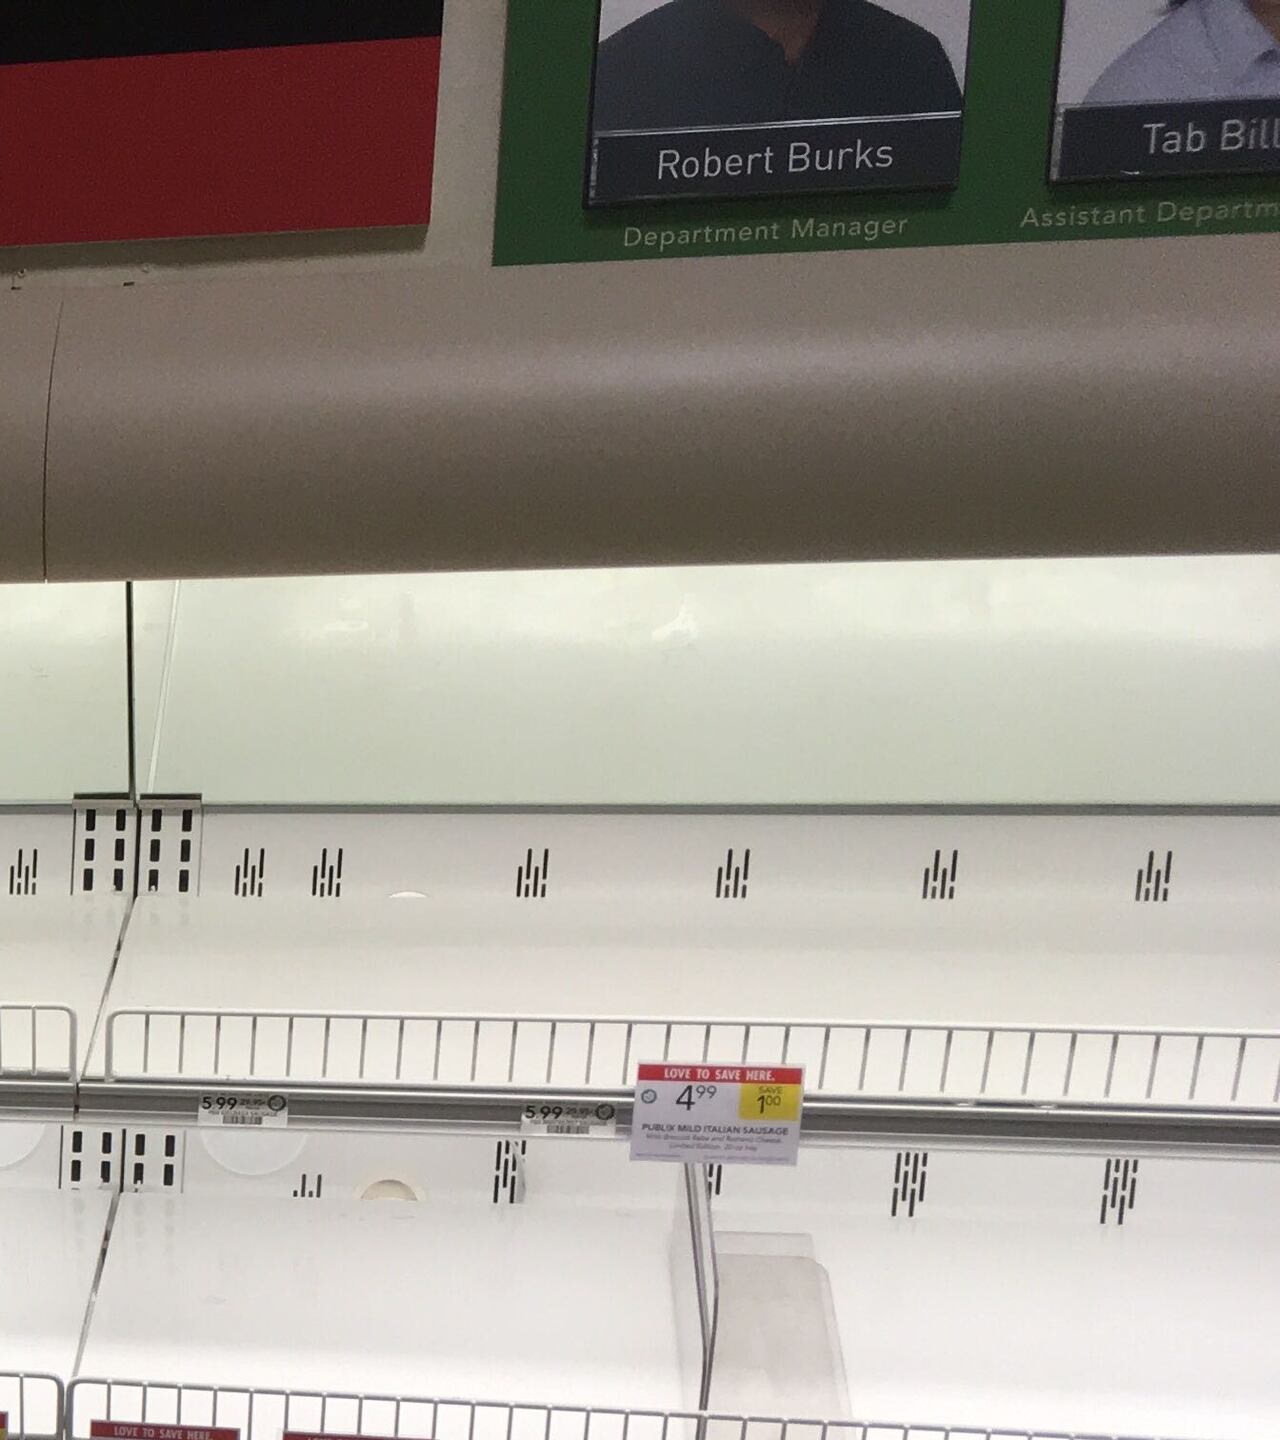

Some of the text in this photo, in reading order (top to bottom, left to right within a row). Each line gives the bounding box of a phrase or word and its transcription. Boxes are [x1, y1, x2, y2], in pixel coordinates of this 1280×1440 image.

[1143, 121, 1206, 154] Tab
[657, 140, 894, 180] Robert Burks
[1021, 206, 1146, 229] Assistant
[624, 215, 908, 251] Department Manager
[664, 1067, 776, 1082] LOVE TO SAVE HERE.
[642, 1123, 789, 1136] PUBLIX MILD ITALIAN SAUSAGE
[114, 1425, 214, 1440] LOVE TO SAVE HERE.
